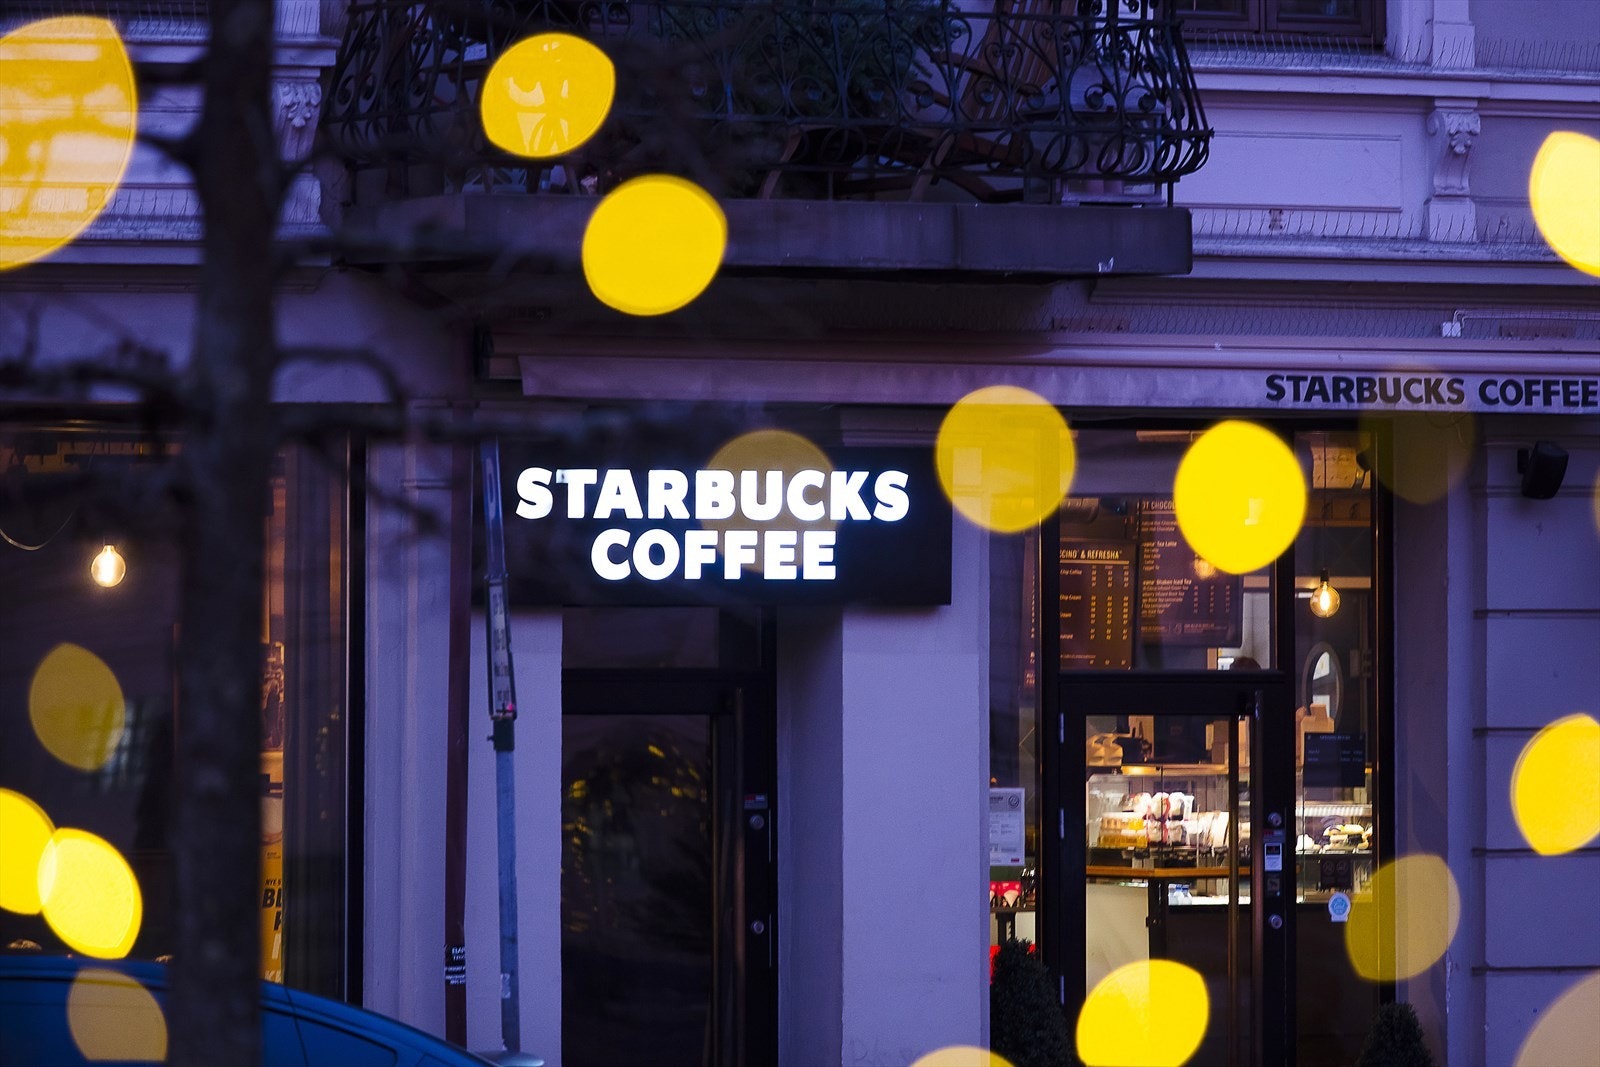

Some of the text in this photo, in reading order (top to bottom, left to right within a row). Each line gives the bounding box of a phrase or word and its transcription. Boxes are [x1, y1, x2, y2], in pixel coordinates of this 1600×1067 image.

[1265, 374, 1599, 408] STARBUCKS COFFEE
[515, 466, 910, 581] STARBUCKS COFFEE
